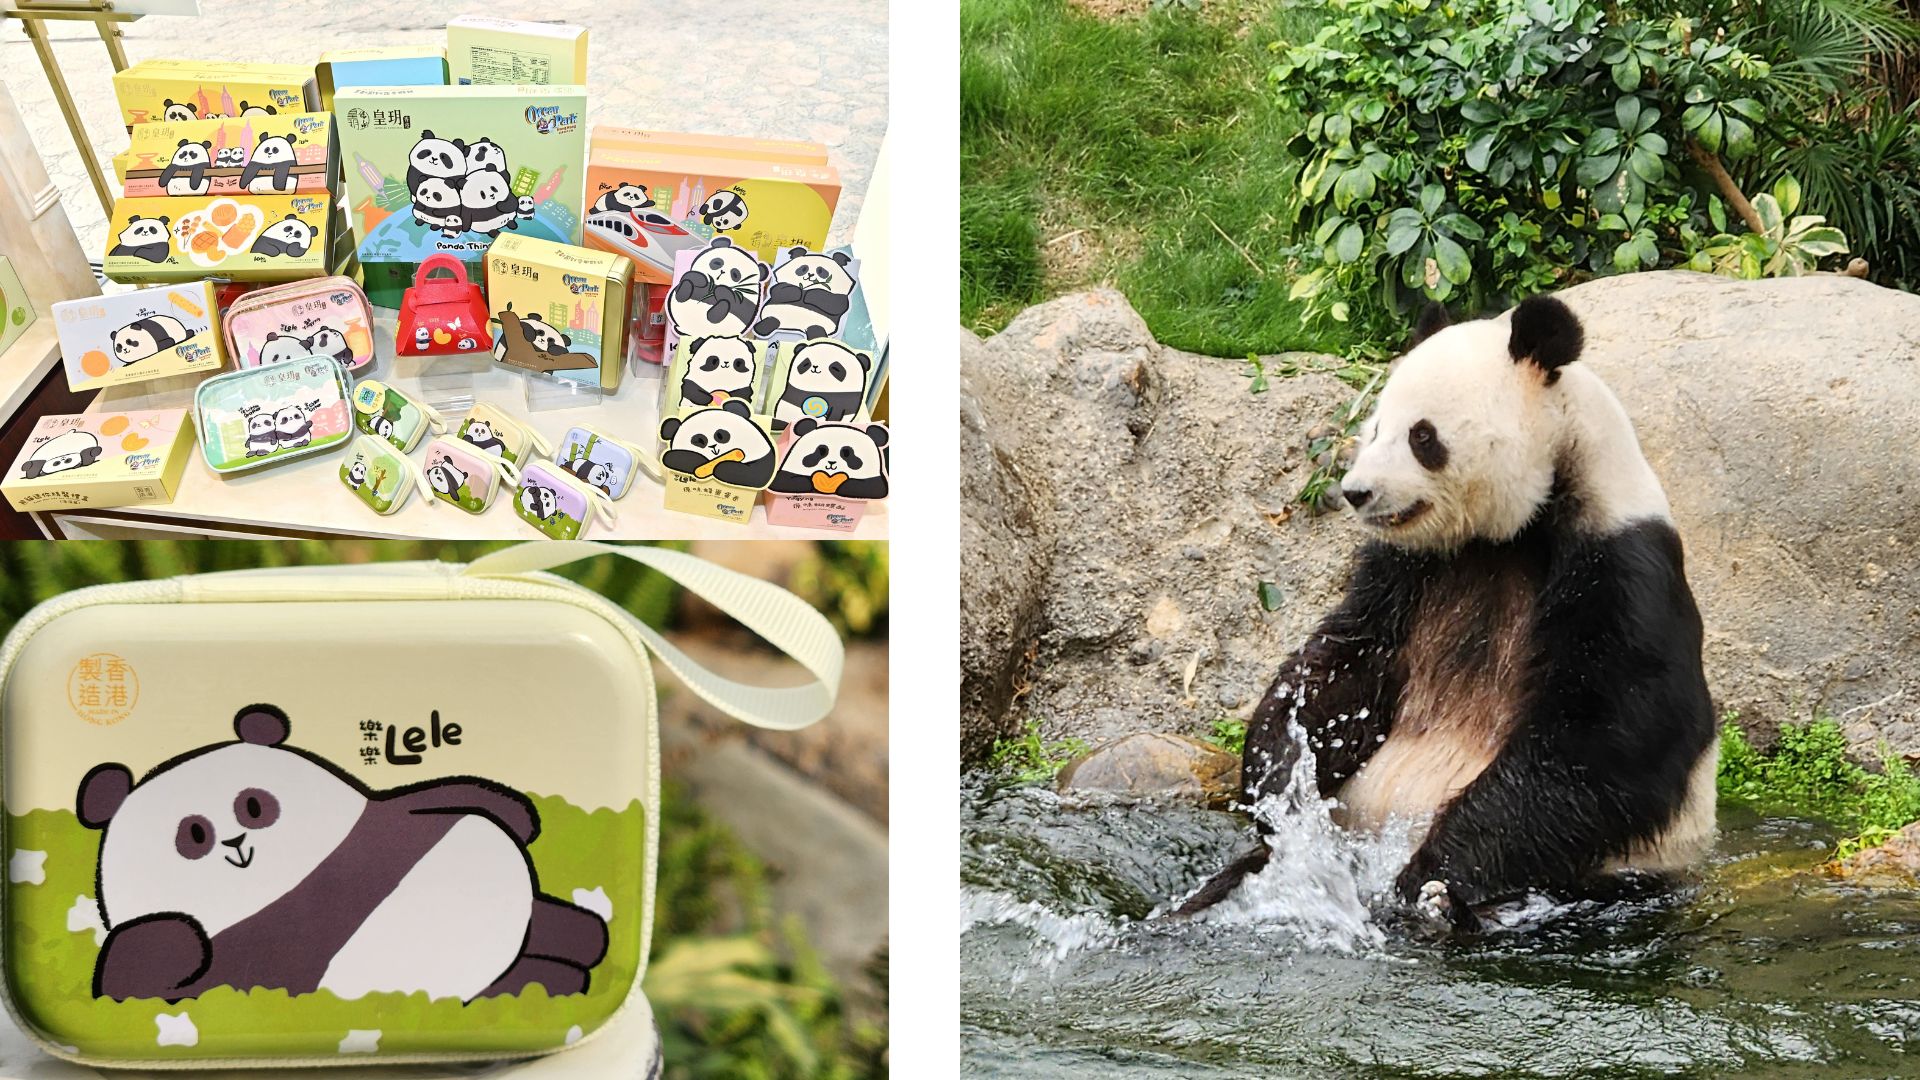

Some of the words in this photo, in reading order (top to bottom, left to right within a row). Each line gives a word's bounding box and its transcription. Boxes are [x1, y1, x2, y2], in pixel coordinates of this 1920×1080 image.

[373, 109, 402, 126] 皇玥
[524, 105, 559, 124] Ocean
[554, 113, 578, 127] Park
[436, 242, 464, 250] Panda
[467, 242, 491, 250] Thin
[359, 719, 383, 765] 樂樂
[385, 709, 462, 766] Lele
